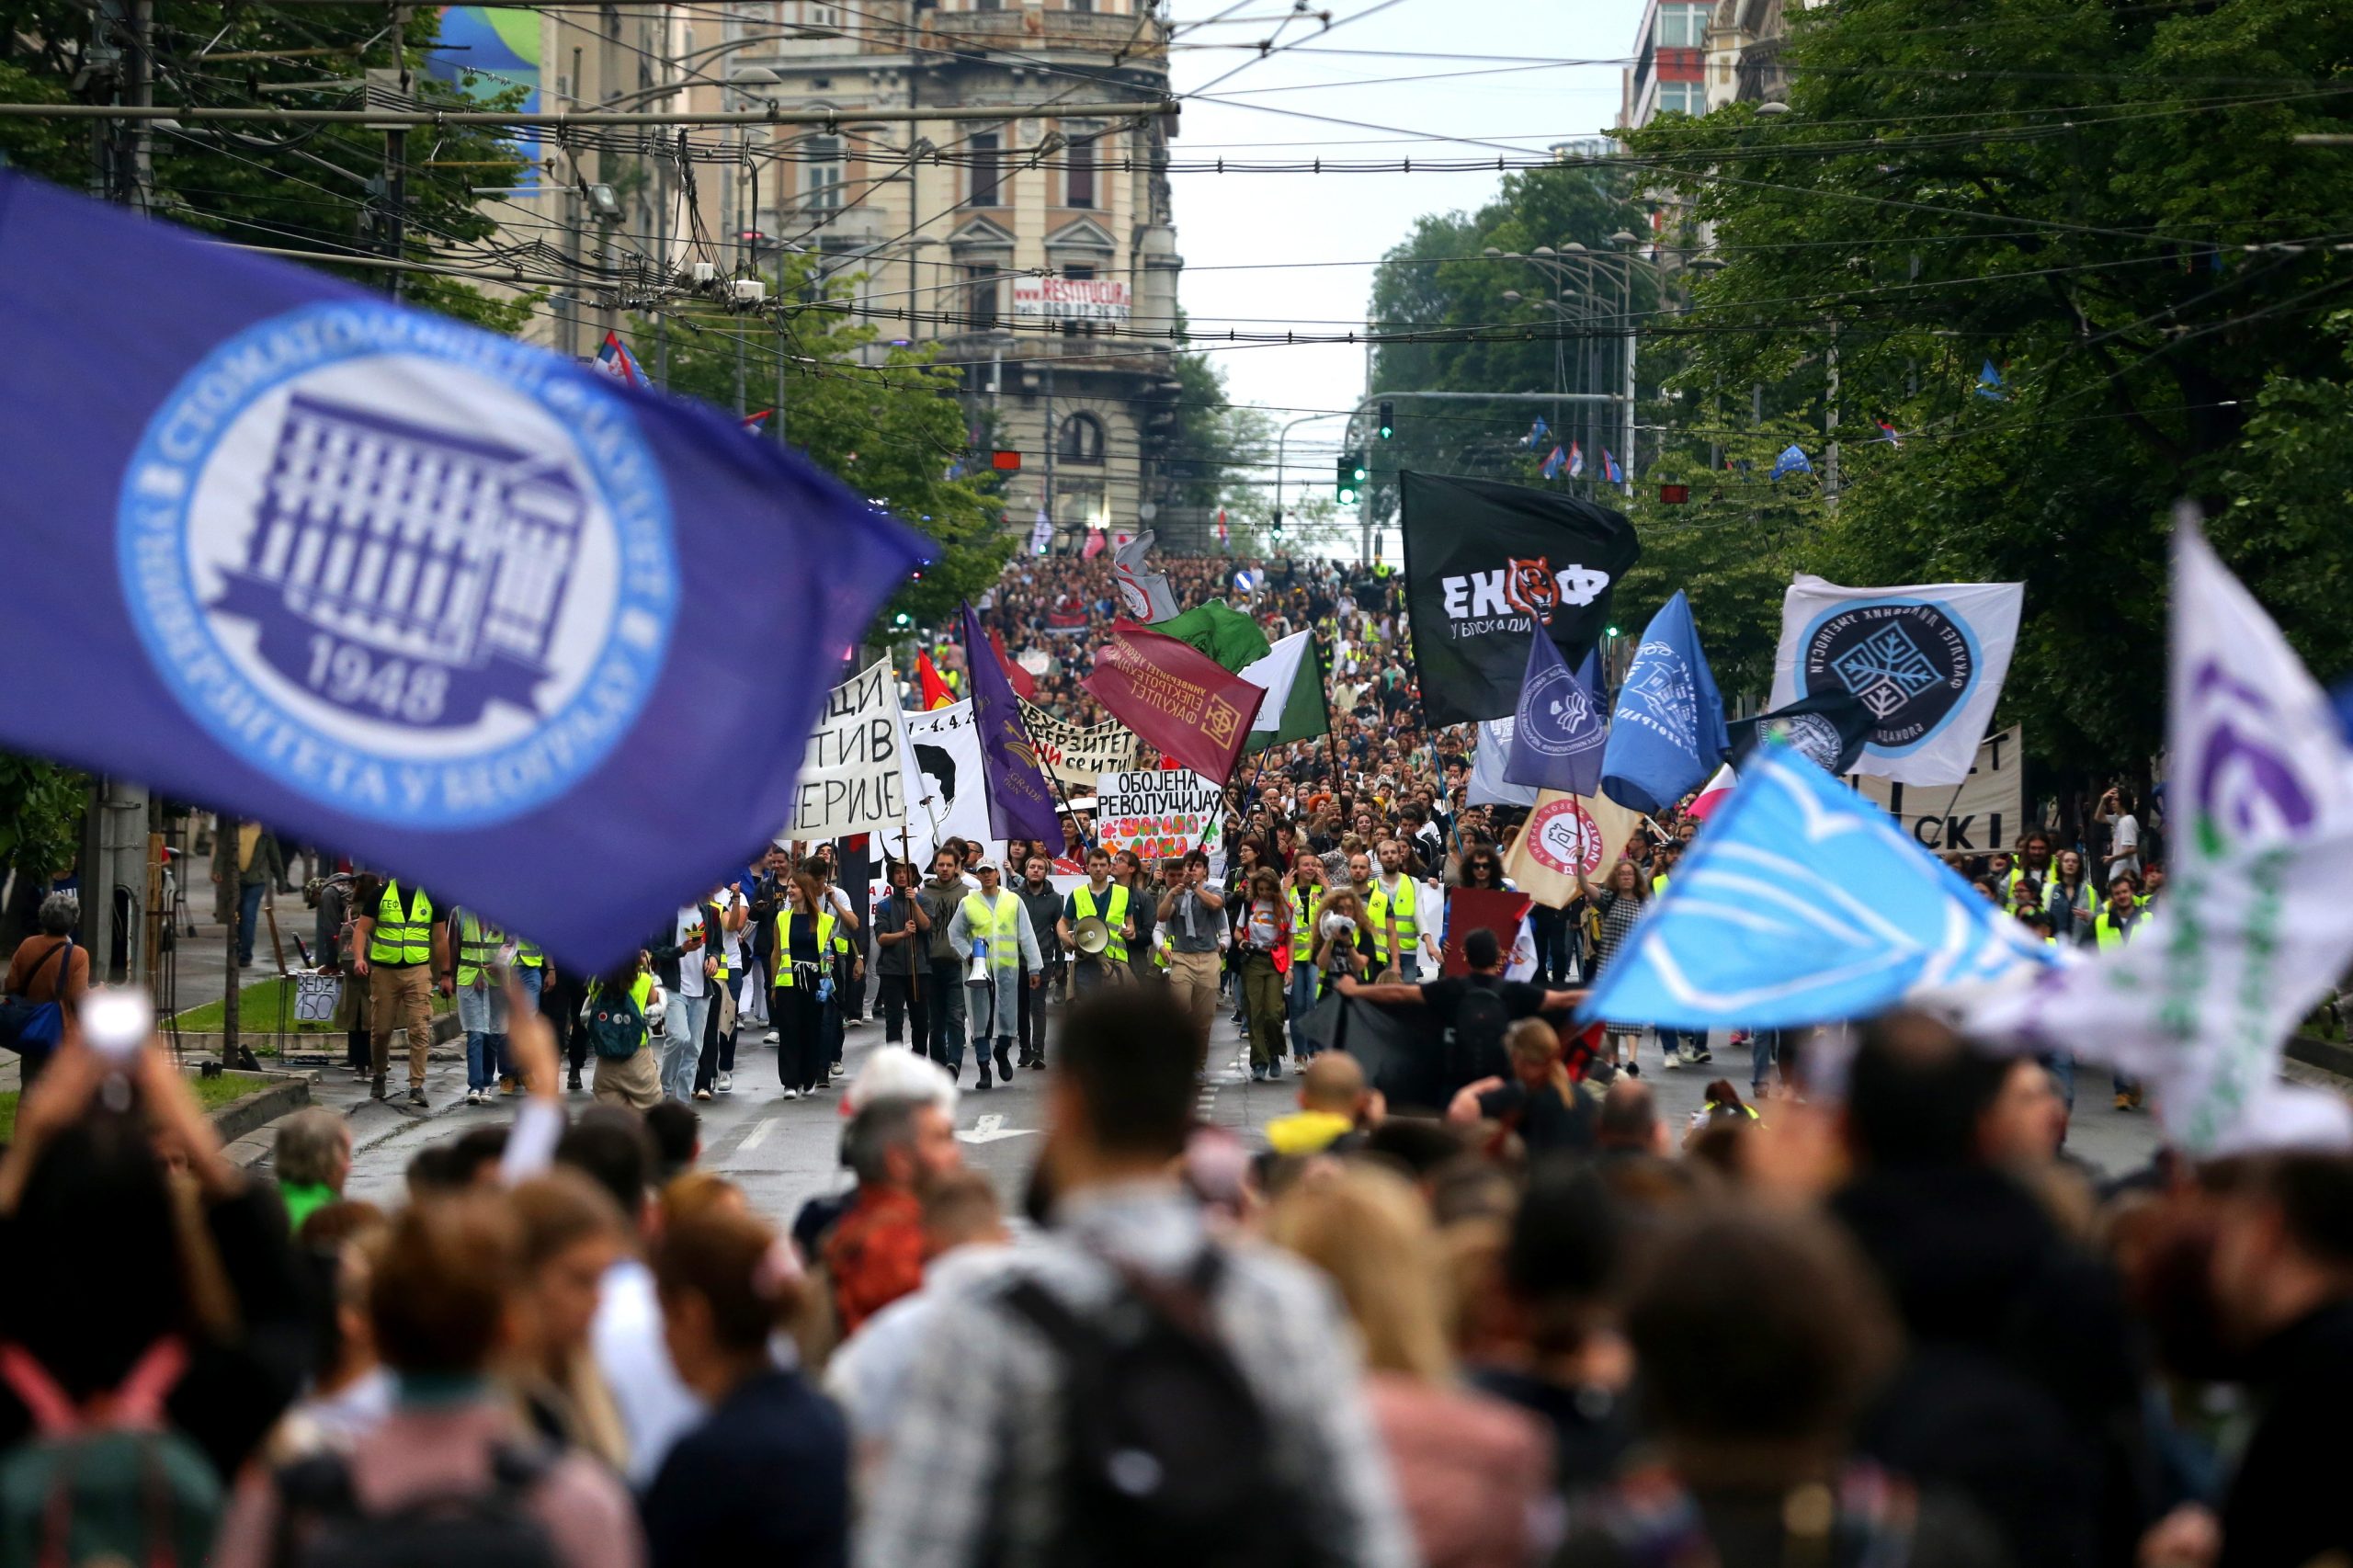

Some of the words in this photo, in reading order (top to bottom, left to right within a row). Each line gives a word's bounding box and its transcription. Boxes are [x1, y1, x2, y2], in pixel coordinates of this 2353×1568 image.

[1461, 618, 1531, 638] БЛОКАДИ
[306, 634, 450, 724] 1948
[1119, 770, 1199, 793] ОБОЈЕНА
[1097, 790, 1222, 817] РЕВОЛУЦИЈА?
[381, 899, 400, 908] ГЕФ
[297, 975, 335, 994] BEDZ
[295, 993, 335, 1020] 150
